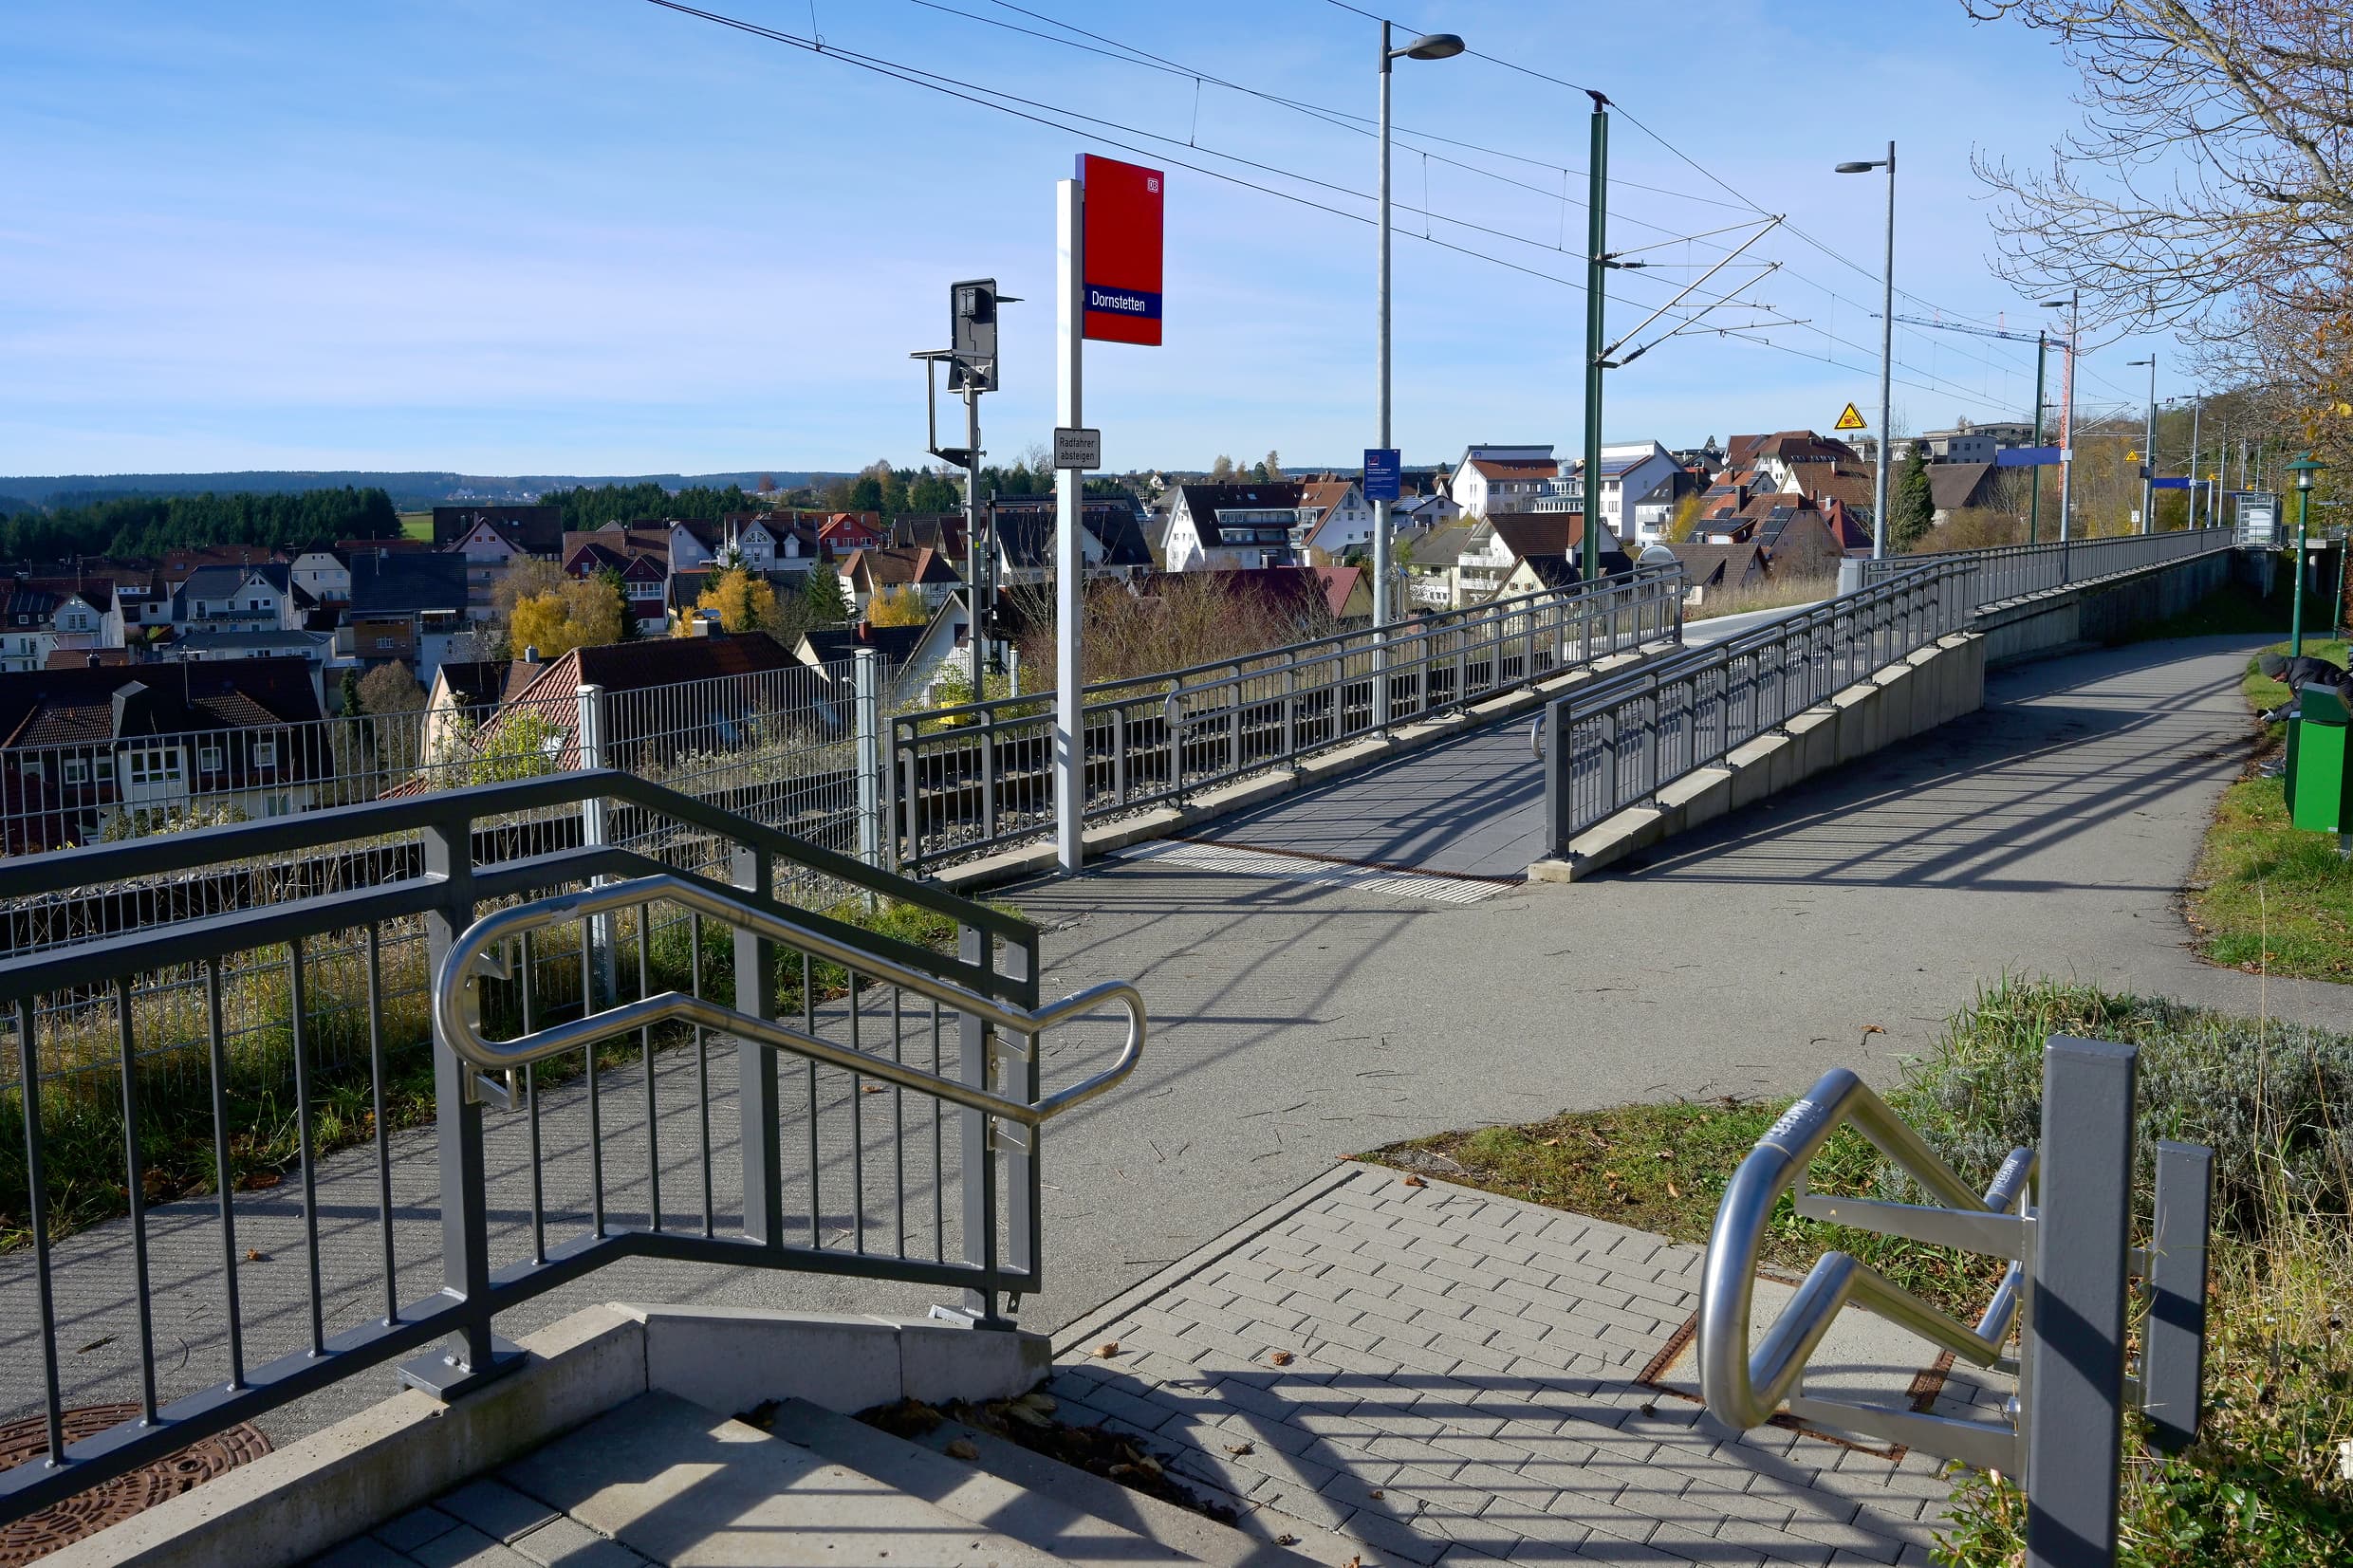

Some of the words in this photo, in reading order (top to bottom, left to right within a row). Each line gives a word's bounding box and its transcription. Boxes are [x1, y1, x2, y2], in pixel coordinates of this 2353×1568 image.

[1148, 178, 1158, 192] DB
[1092, 290, 1145, 312] Dornstetten
[1059, 436, 1094, 448] Radfahrer
[1061, 451, 1095, 463] absteigen
